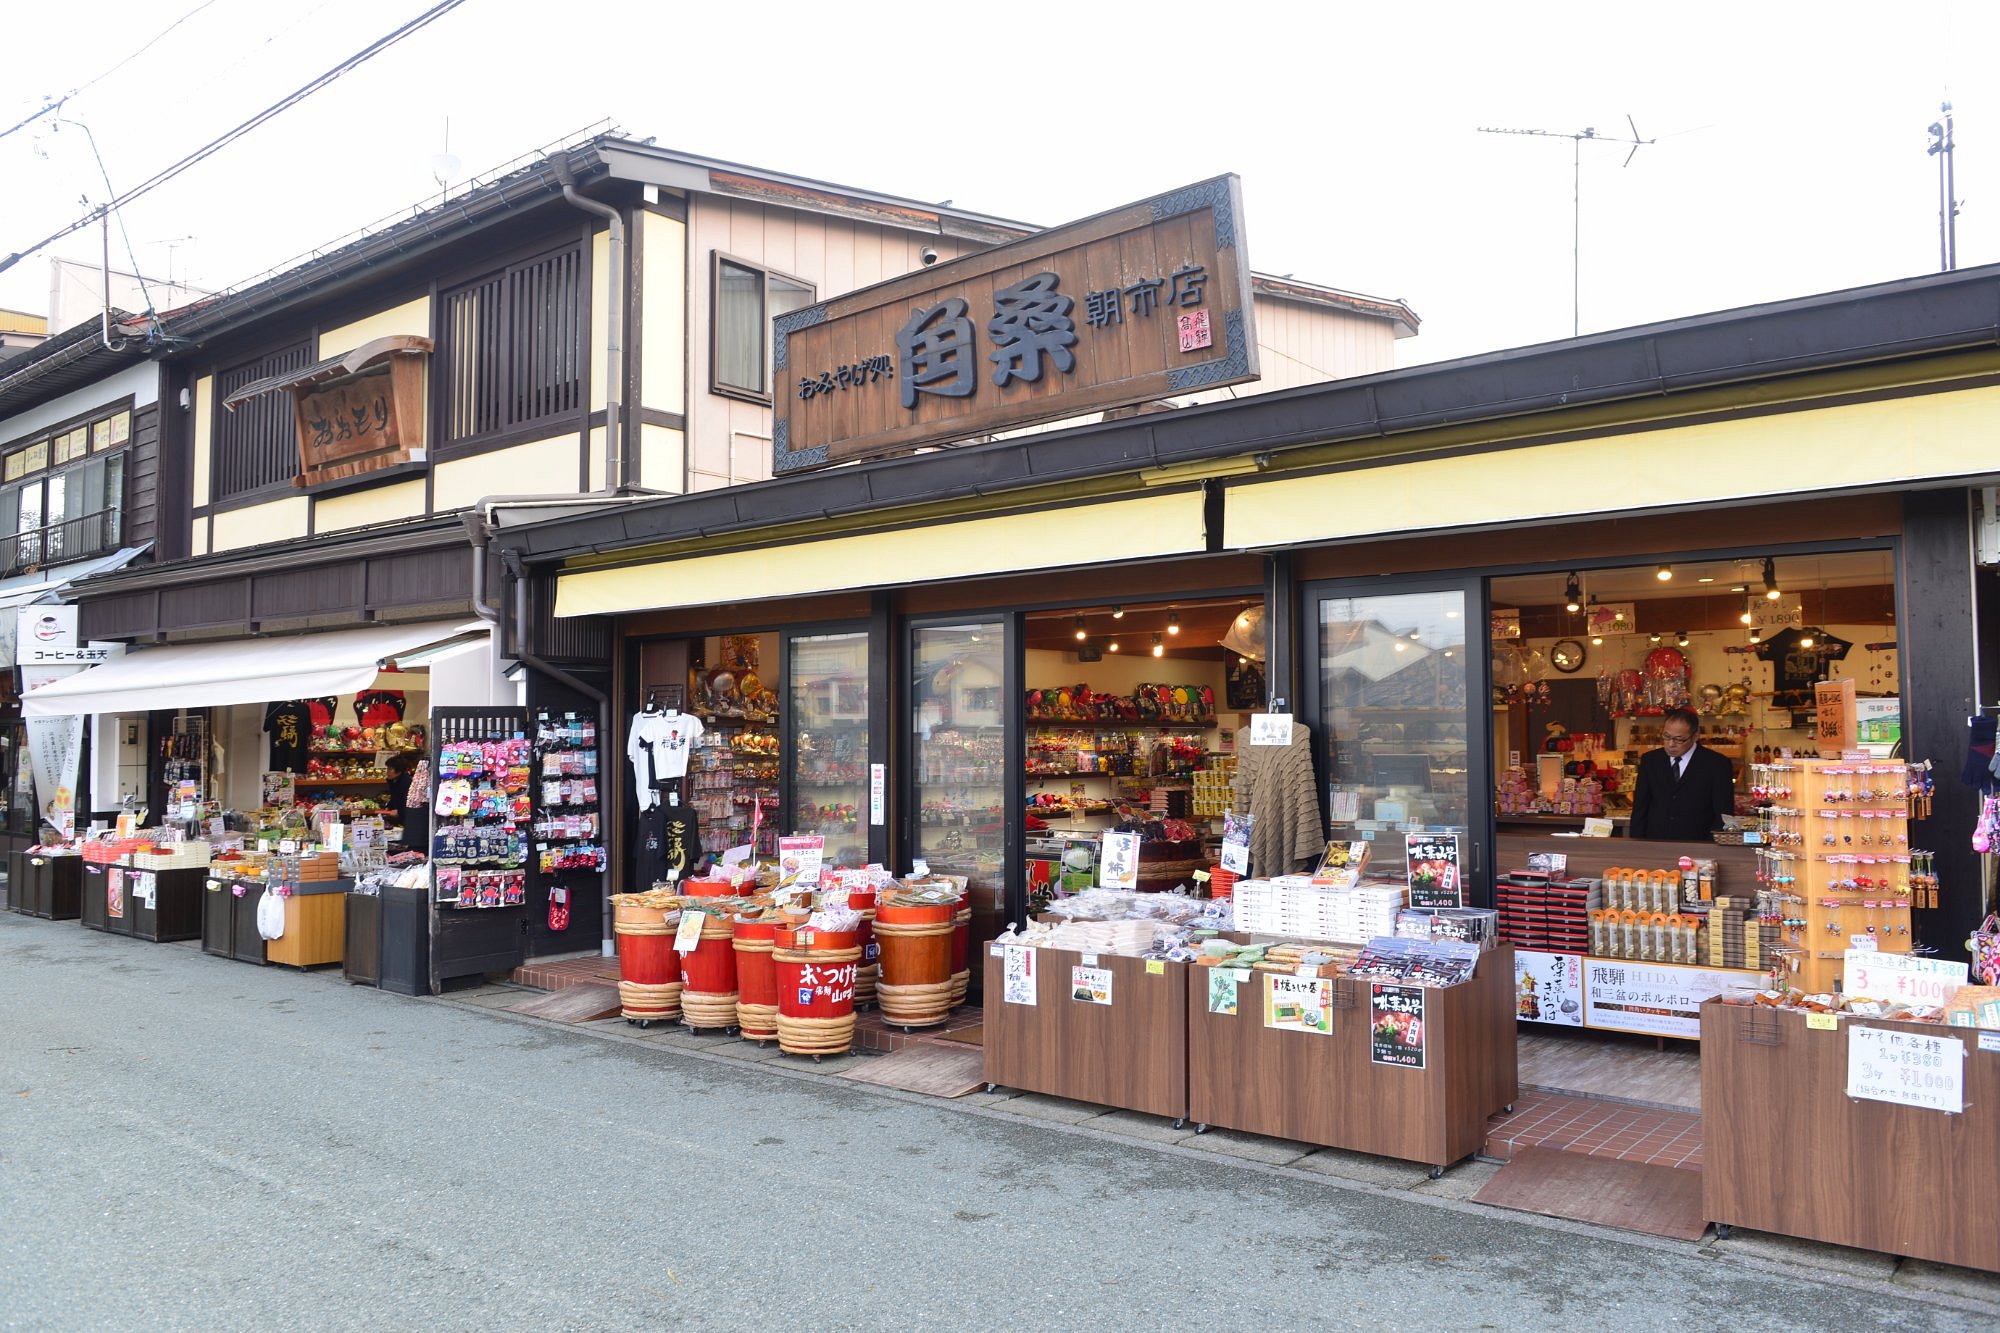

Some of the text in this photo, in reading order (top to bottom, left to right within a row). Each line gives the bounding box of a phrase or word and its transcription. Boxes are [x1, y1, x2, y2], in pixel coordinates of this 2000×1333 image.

[798, 265, 1207, 409] おみやげ処 角桑 朝市店
[1592, 967, 1679, 985] 飛騨 HIDA
[1543, 982, 1560, 1021] きんつば
[1859, 1029, 1942, 1054] みそ他各種
[1901, 1050, 1943, 1067] ¥380
[1900, 1067, 1954, 1091] ¥1000
